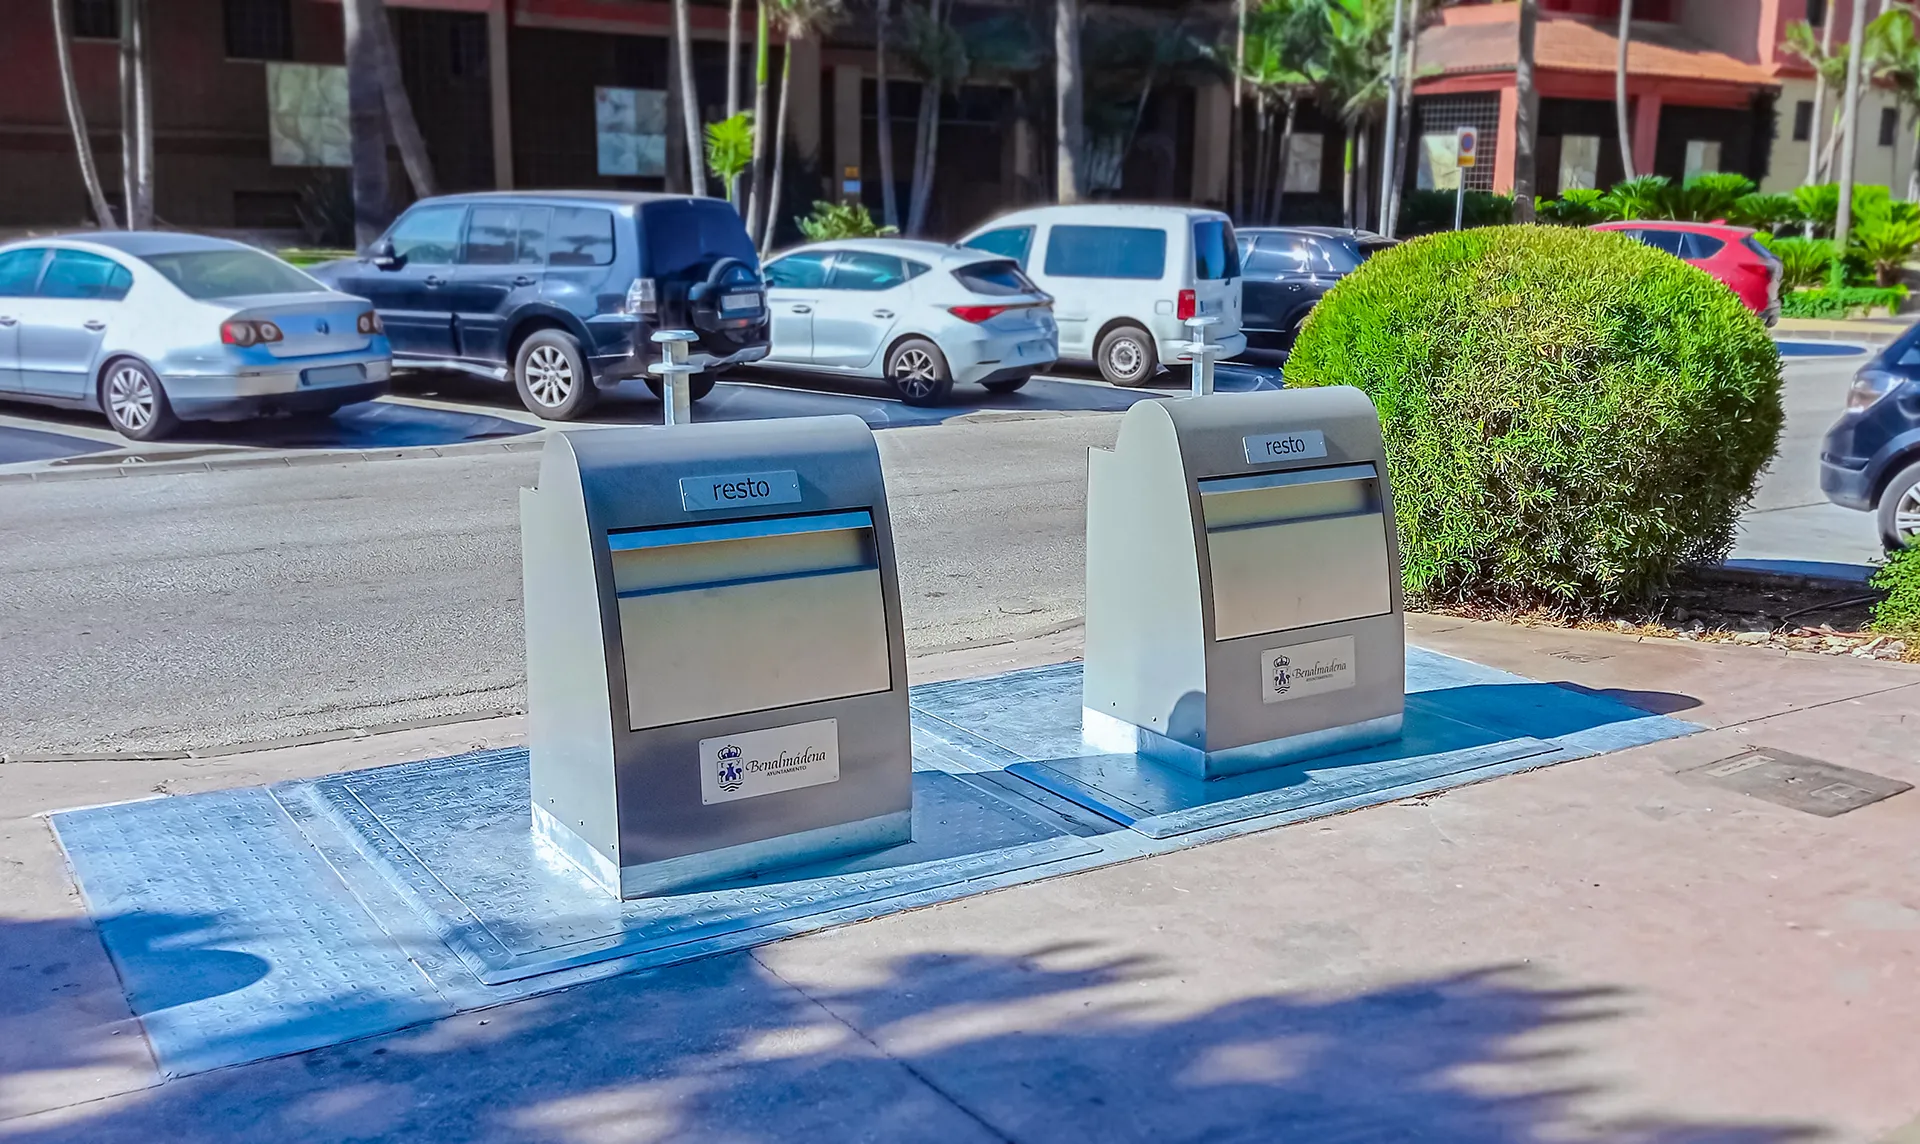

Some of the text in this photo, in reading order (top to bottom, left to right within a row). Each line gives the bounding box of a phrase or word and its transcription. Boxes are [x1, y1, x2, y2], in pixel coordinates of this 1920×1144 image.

[1265, 436, 1305, 456] resto
[712, 477, 770, 501] resto
[745, 746, 826, 773] Benalmádena
[766, 765, 807, 777] AYUNTAMIENTO
